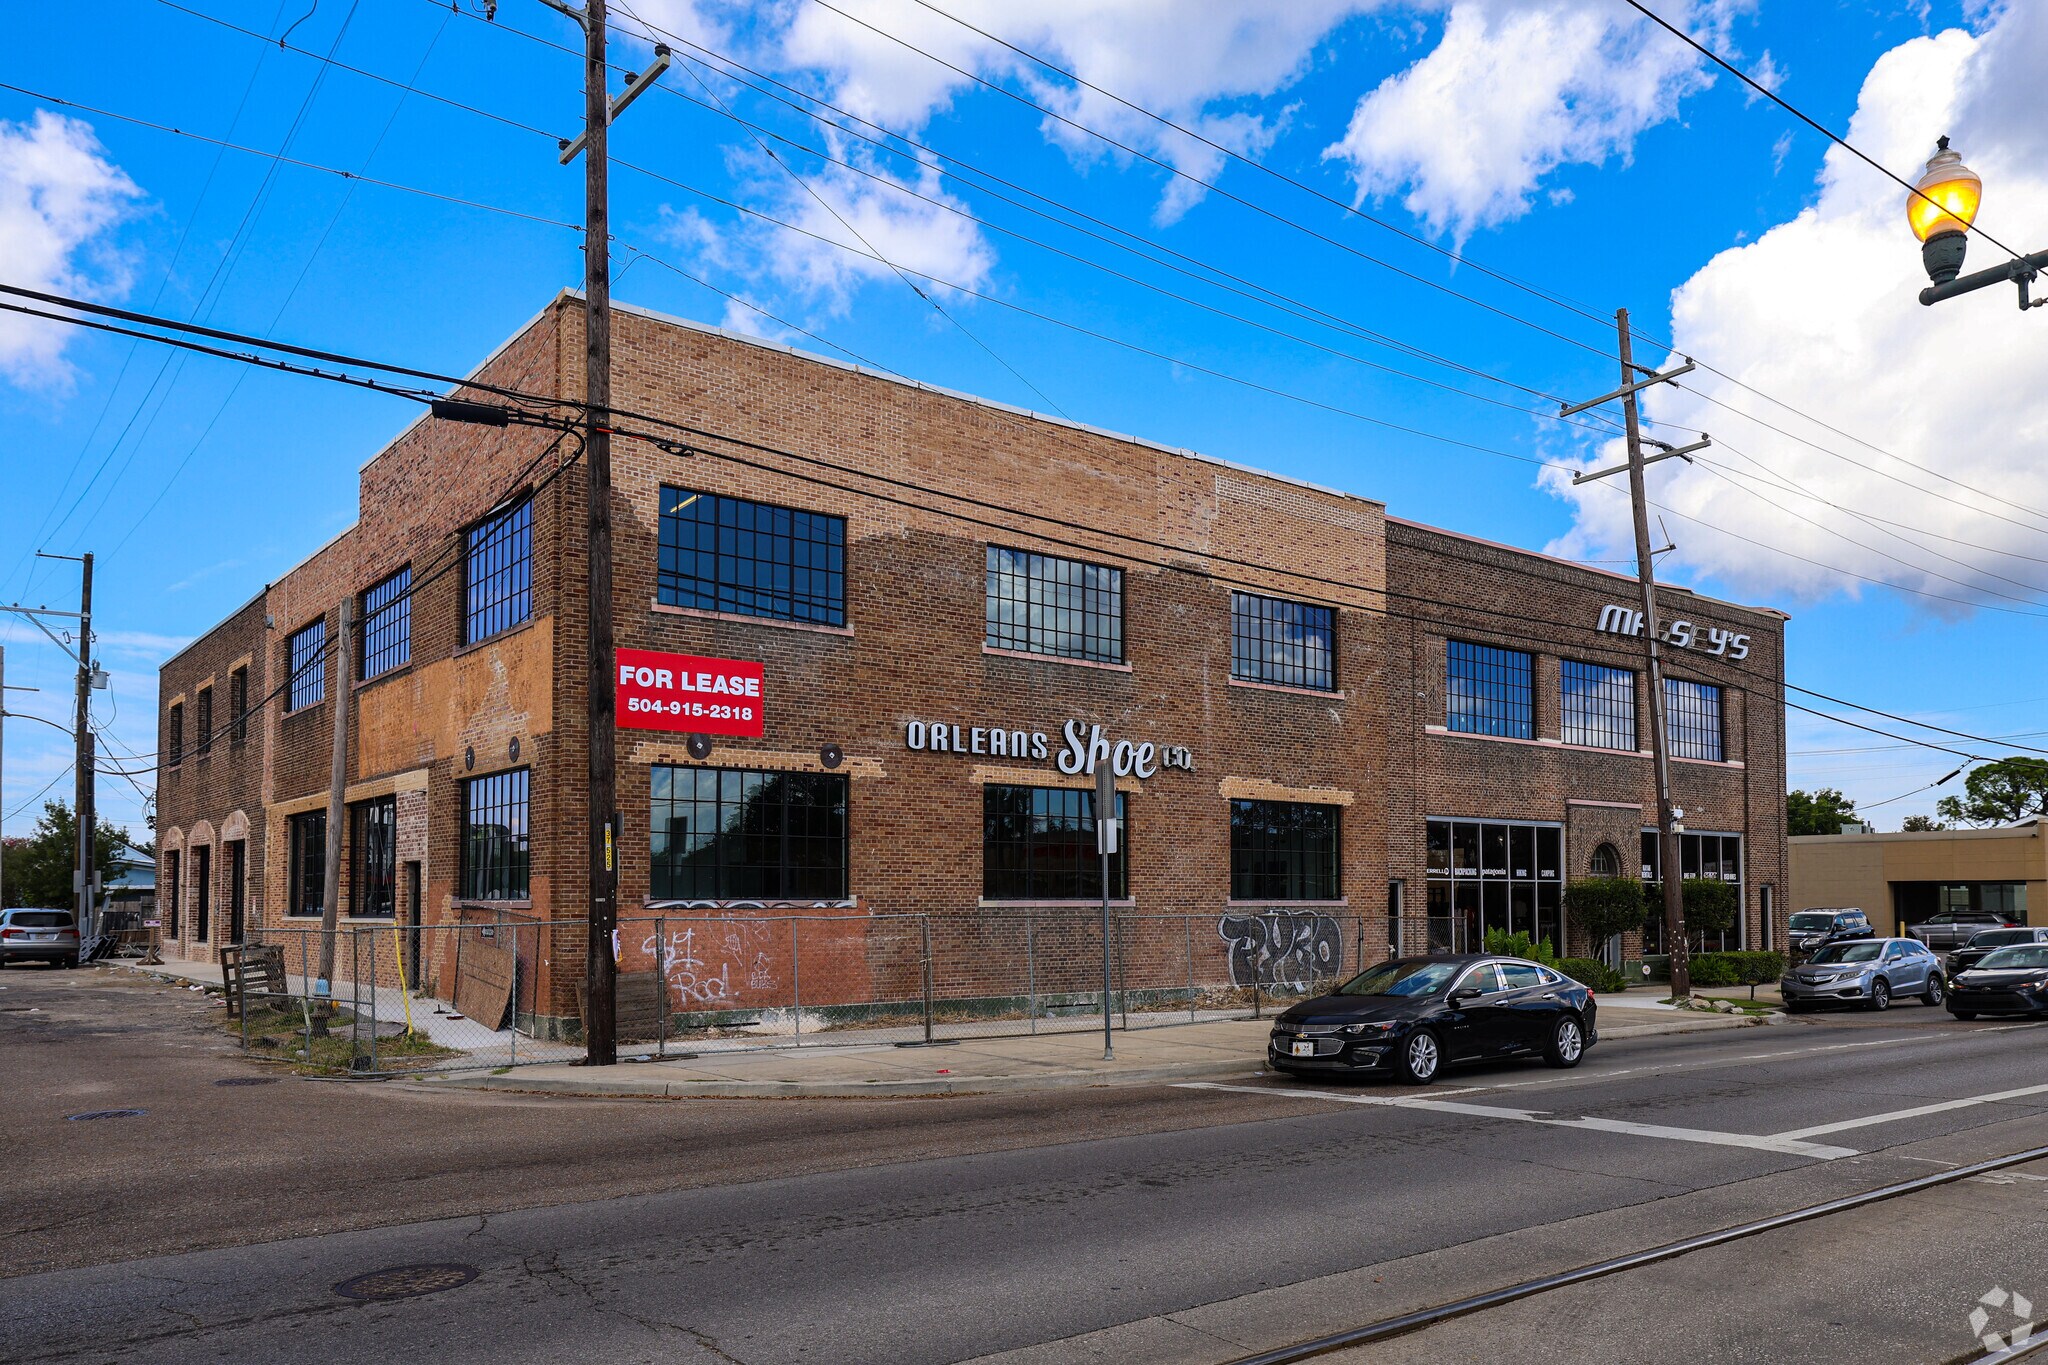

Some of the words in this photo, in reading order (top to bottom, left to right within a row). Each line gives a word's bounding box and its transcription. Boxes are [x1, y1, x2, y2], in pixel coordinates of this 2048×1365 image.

[619, 665, 673, 689] FOR
[681, 671, 760, 697] LEASE
[627, 697, 753, 721] 504-915-2318
[906, 720, 1049, 760] ORLEANS
[1056, 718, 1157, 779] Shoe
